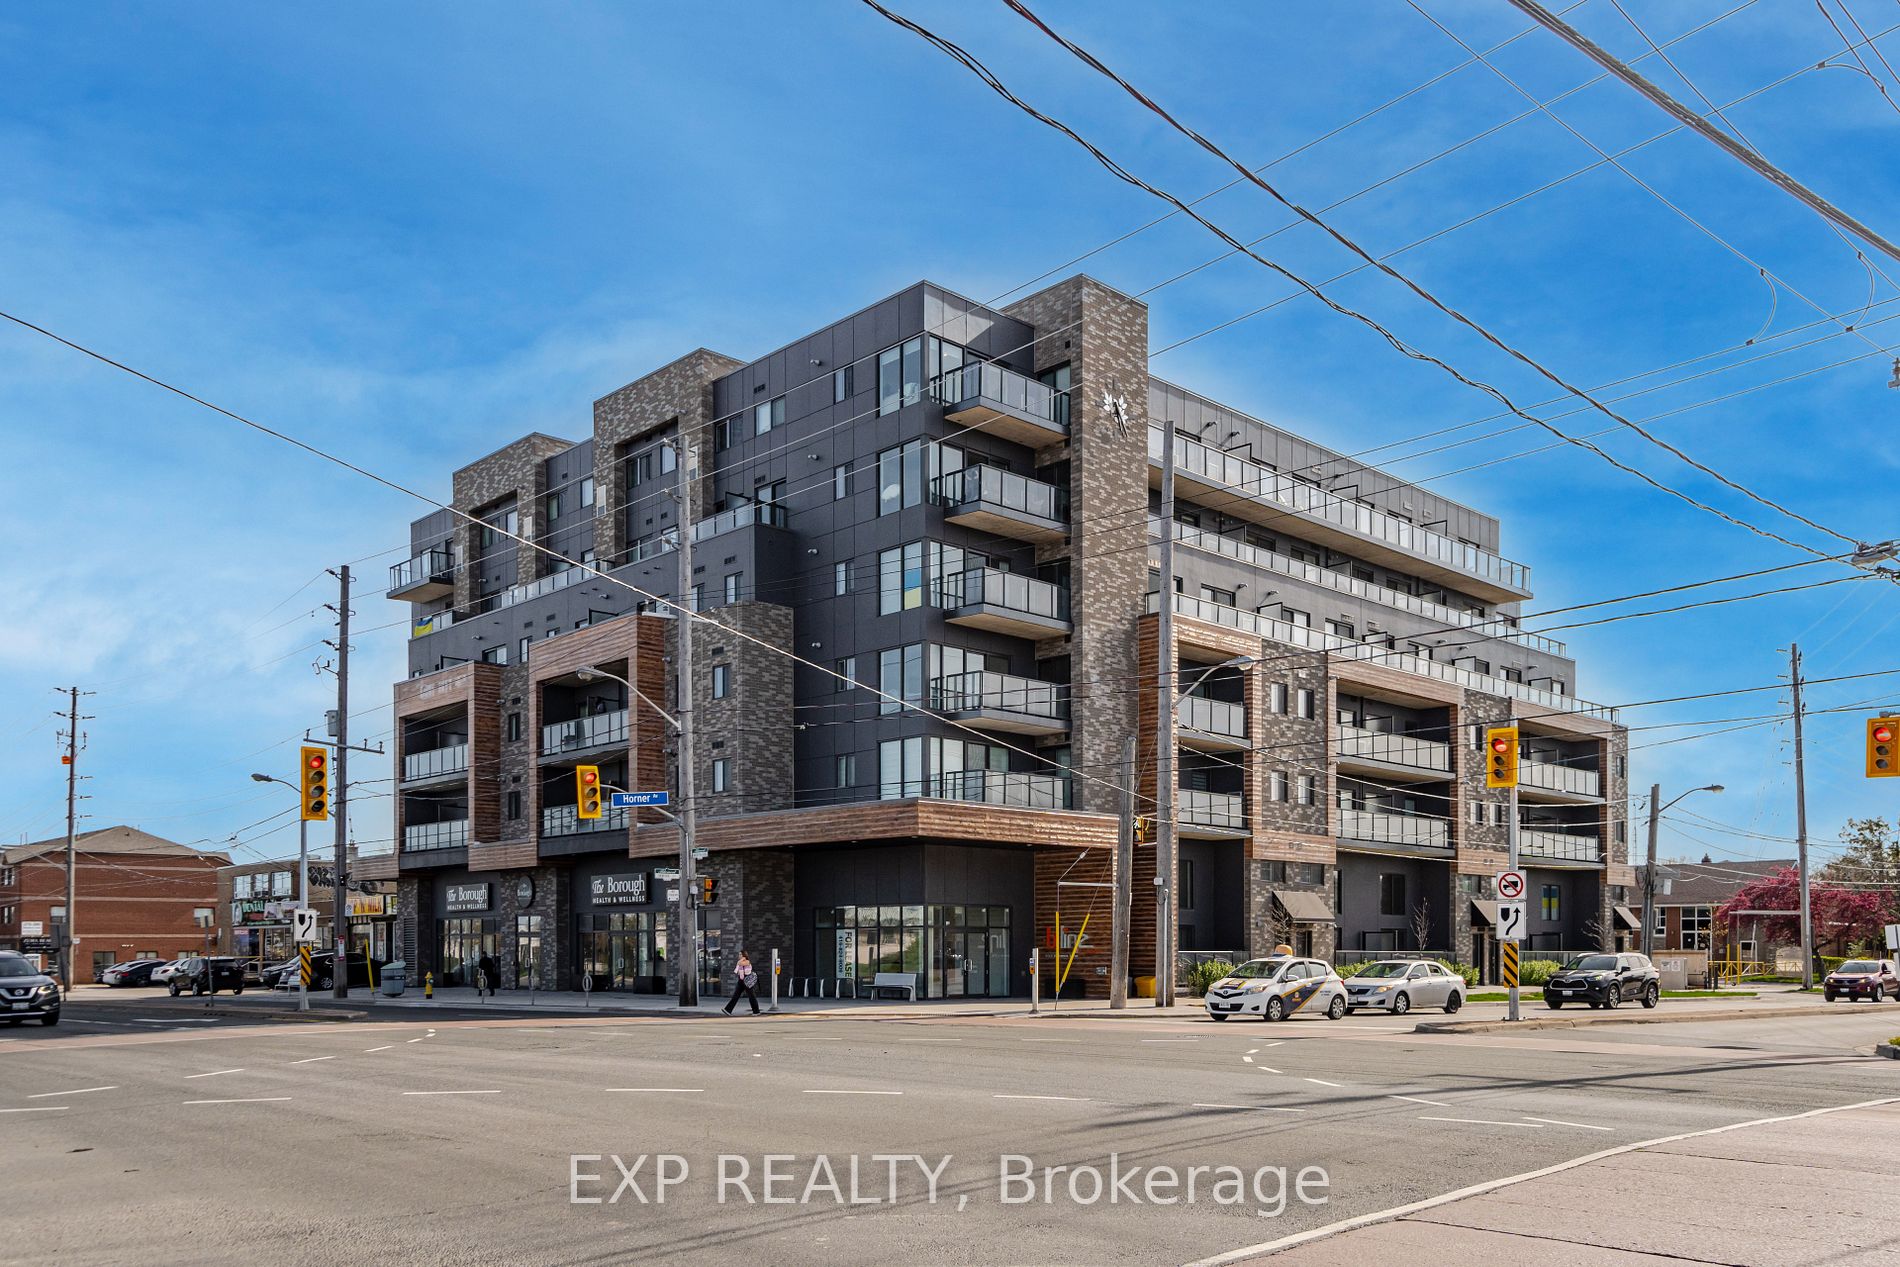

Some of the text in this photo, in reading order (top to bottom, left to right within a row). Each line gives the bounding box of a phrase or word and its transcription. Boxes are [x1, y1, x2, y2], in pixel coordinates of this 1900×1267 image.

[623, 795, 650, 803] Horner
[607, 874, 645, 896] Borough
[458, 884, 487, 903] Borough
[592, 896, 611, 904] HEALTH
[619, 895, 645, 903] WELLNESS
[466, 902, 487, 910] WELLNESS
[844, 931, 853, 978] FOR LEASE
